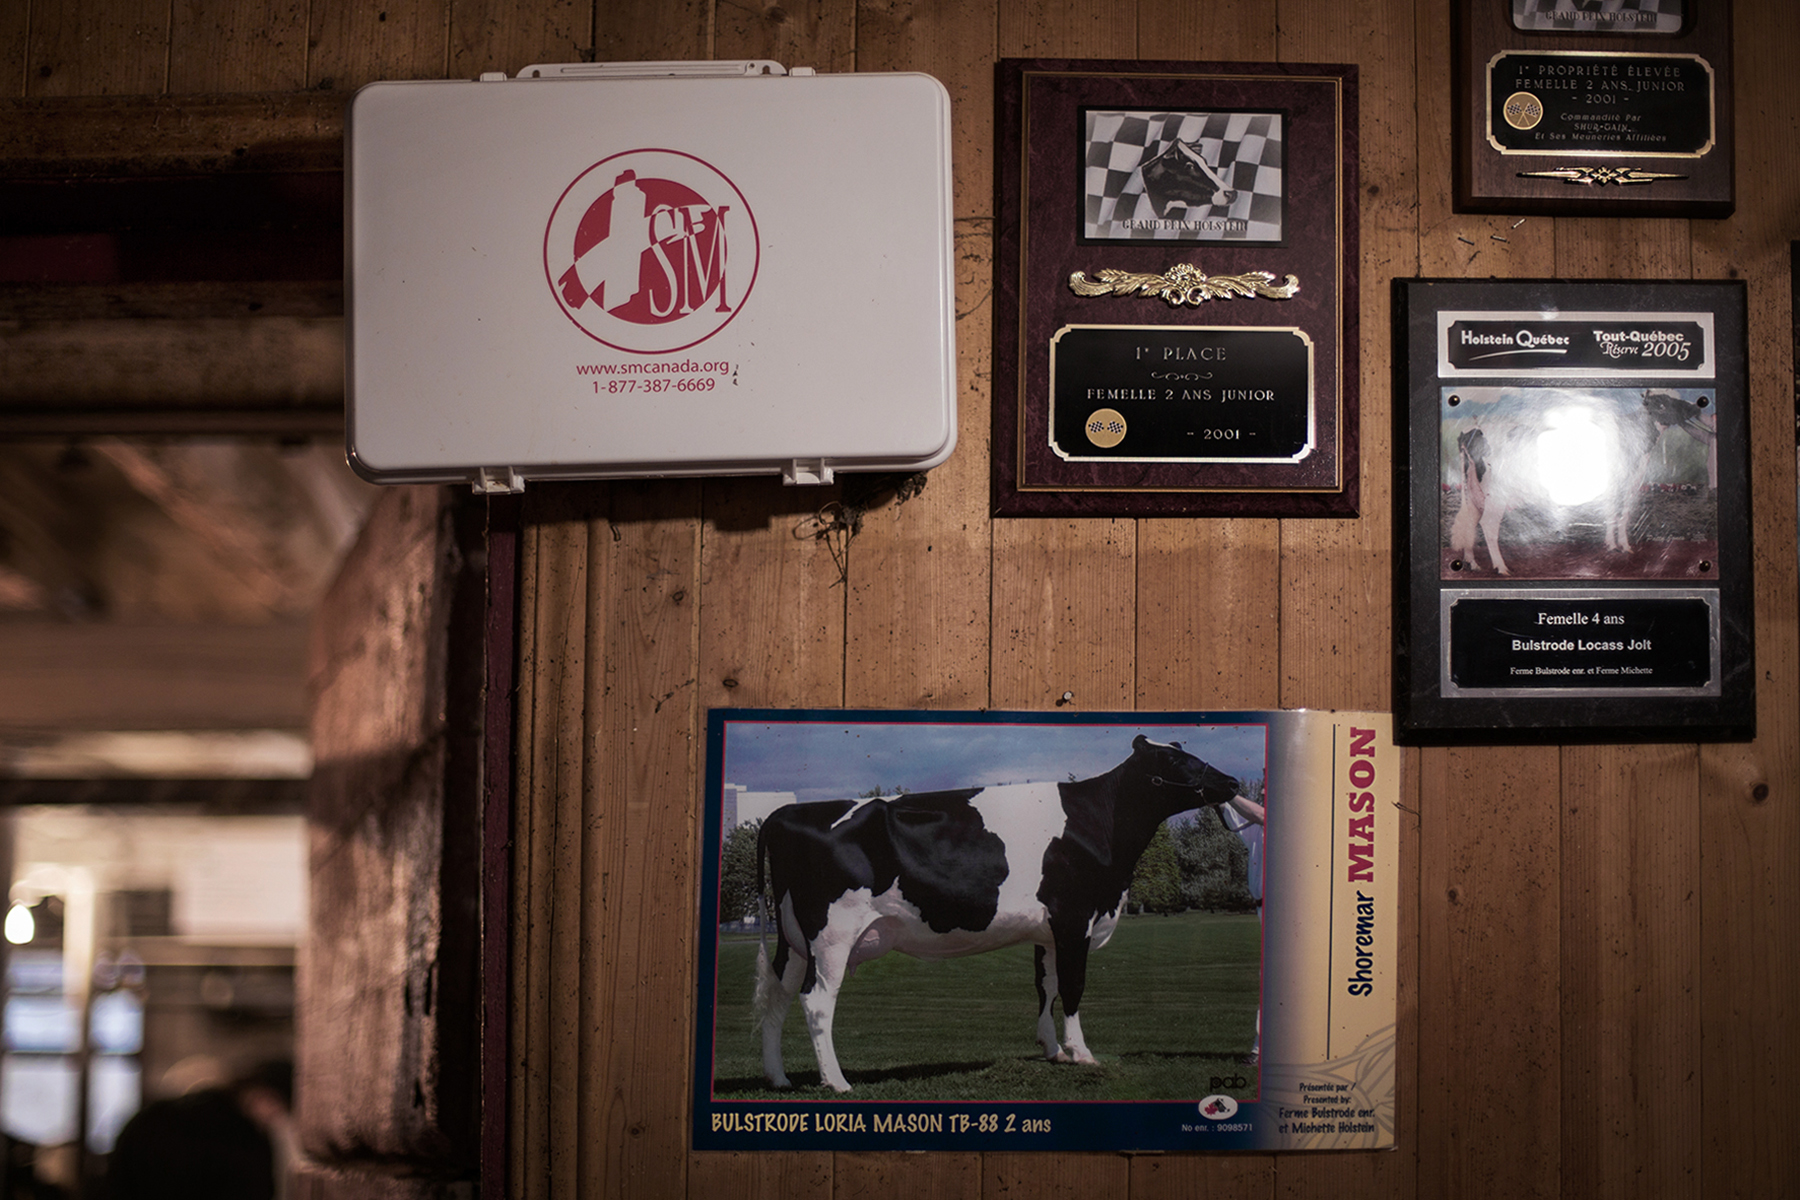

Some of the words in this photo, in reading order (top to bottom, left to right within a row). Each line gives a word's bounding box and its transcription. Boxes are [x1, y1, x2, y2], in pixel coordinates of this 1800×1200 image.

[1538, 65, 1619, 77] PROPRIÉTÉ
[1627, 65, 1682, 78] ÉLEVÉE
[1515, 79, 1579, 90] FEMELLE
[1586, 80, 1594, 90] 2
[1601, 81, 1629, 91] ANS
[1637, 81, 1686, 93] JUNIOR
[1585, 94, 1617, 105] 2001
[1549, 131, 1567, 141] Ses
[1122, 218, 1161, 232] GRAND
[1164, 219, 1190, 232] PRIX
[1194, 220, 1249, 233] HOLSTEIN
[1461, 330, 1514, 345] Holstein
[1515, 329, 1570, 348] Québec
[1593, 330, 1685, 343] Tout-Québec
[1163, 346, 1227, 361] PLACE
[1641, 342, 1691, 361] 2005
[576, 359, 730, 376] www.smcanada.org
[592, 378, 716, 394] 1-877-387-6669
[1087, 388, 1157, 400] FEMELLE
[1165, 388, 1174, 400] 2
[1182, 389, 1212, 401] ANS
[1221, 389, 1275, 403] JUNIOR
[1203, 428, 1240, 440] 2001
[1537, 612, 1589, 625] Femelle
[1591, 612, 1600, 625] 4
[1603, 615, 1625, 625] ans
[1512, 639, 1575, 651] Bulstrode
[1577, 639, 1624, 651] Locass
[1510, 667, 1534, 675] Ferme
[1535, 667, 1571, 675] Bulstrode
[1596, 667, 1619, 675] Ferme
[1620, 666, 1653, 675] Michette
[1347, 726, 1377, 883] MASON
[1347, 890, 1375, 997] Shoremar
[1209, 1073, 1247, 1092] pab
[1299, 1083, 1335, 1092] Présentée
[1336, 1084, 1349, 1093] par
[1303, 1095, 1339, 1104] Presented
[1279, 1107, 1309, 1119] Ferme
[1311, 1107, 1356, 1119] Bulstrode
[1358, 1109, 1376, 1119] enr.
[711, 1112, 809, 1133] BULSTRODE
[814, 1112, 866, 1133] LORIA
[873, 1112, 943, 1133] MASON
[949, 1113, 999, 1133] TB-88
[1003, 1113, 1017, 1133] 2
[1021, 1116, 1052, 1133] ans
[1181, 1123, 1193, 1132] No
[1194, 1124, 1210, 1132] enr.
[1216, 1123, 1253, 1133] 9098571
[1279, 1123, 1289, 1134] et
[1291, 1122, 1335, 1134] Michette
[1338, 1121, 1375, 1134] Holstein
